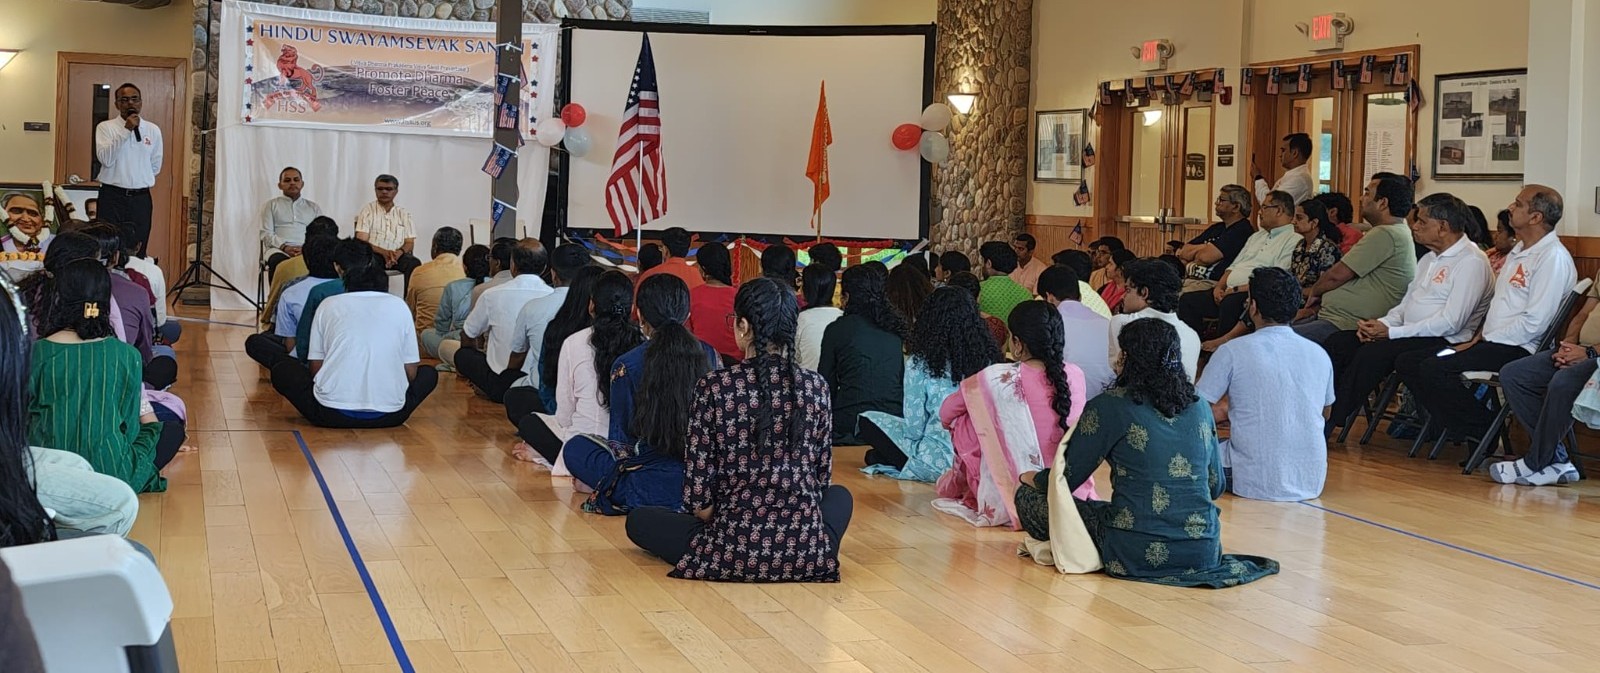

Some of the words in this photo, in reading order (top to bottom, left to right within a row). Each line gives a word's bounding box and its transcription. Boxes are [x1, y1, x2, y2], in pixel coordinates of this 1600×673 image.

[260, 23, 322, 43] HINDU
[327, 29, 460, 53] SWAYAMSEVAK
[464, 39, 524, 55] SAN
[356, 67, 412, 79] Promote
[415, 70, 464, 84] Dharma
[369, 83, 409, 96] Foster
[412, 85, 449, 98] Peace
[277, 100, 306, 113] HSS
